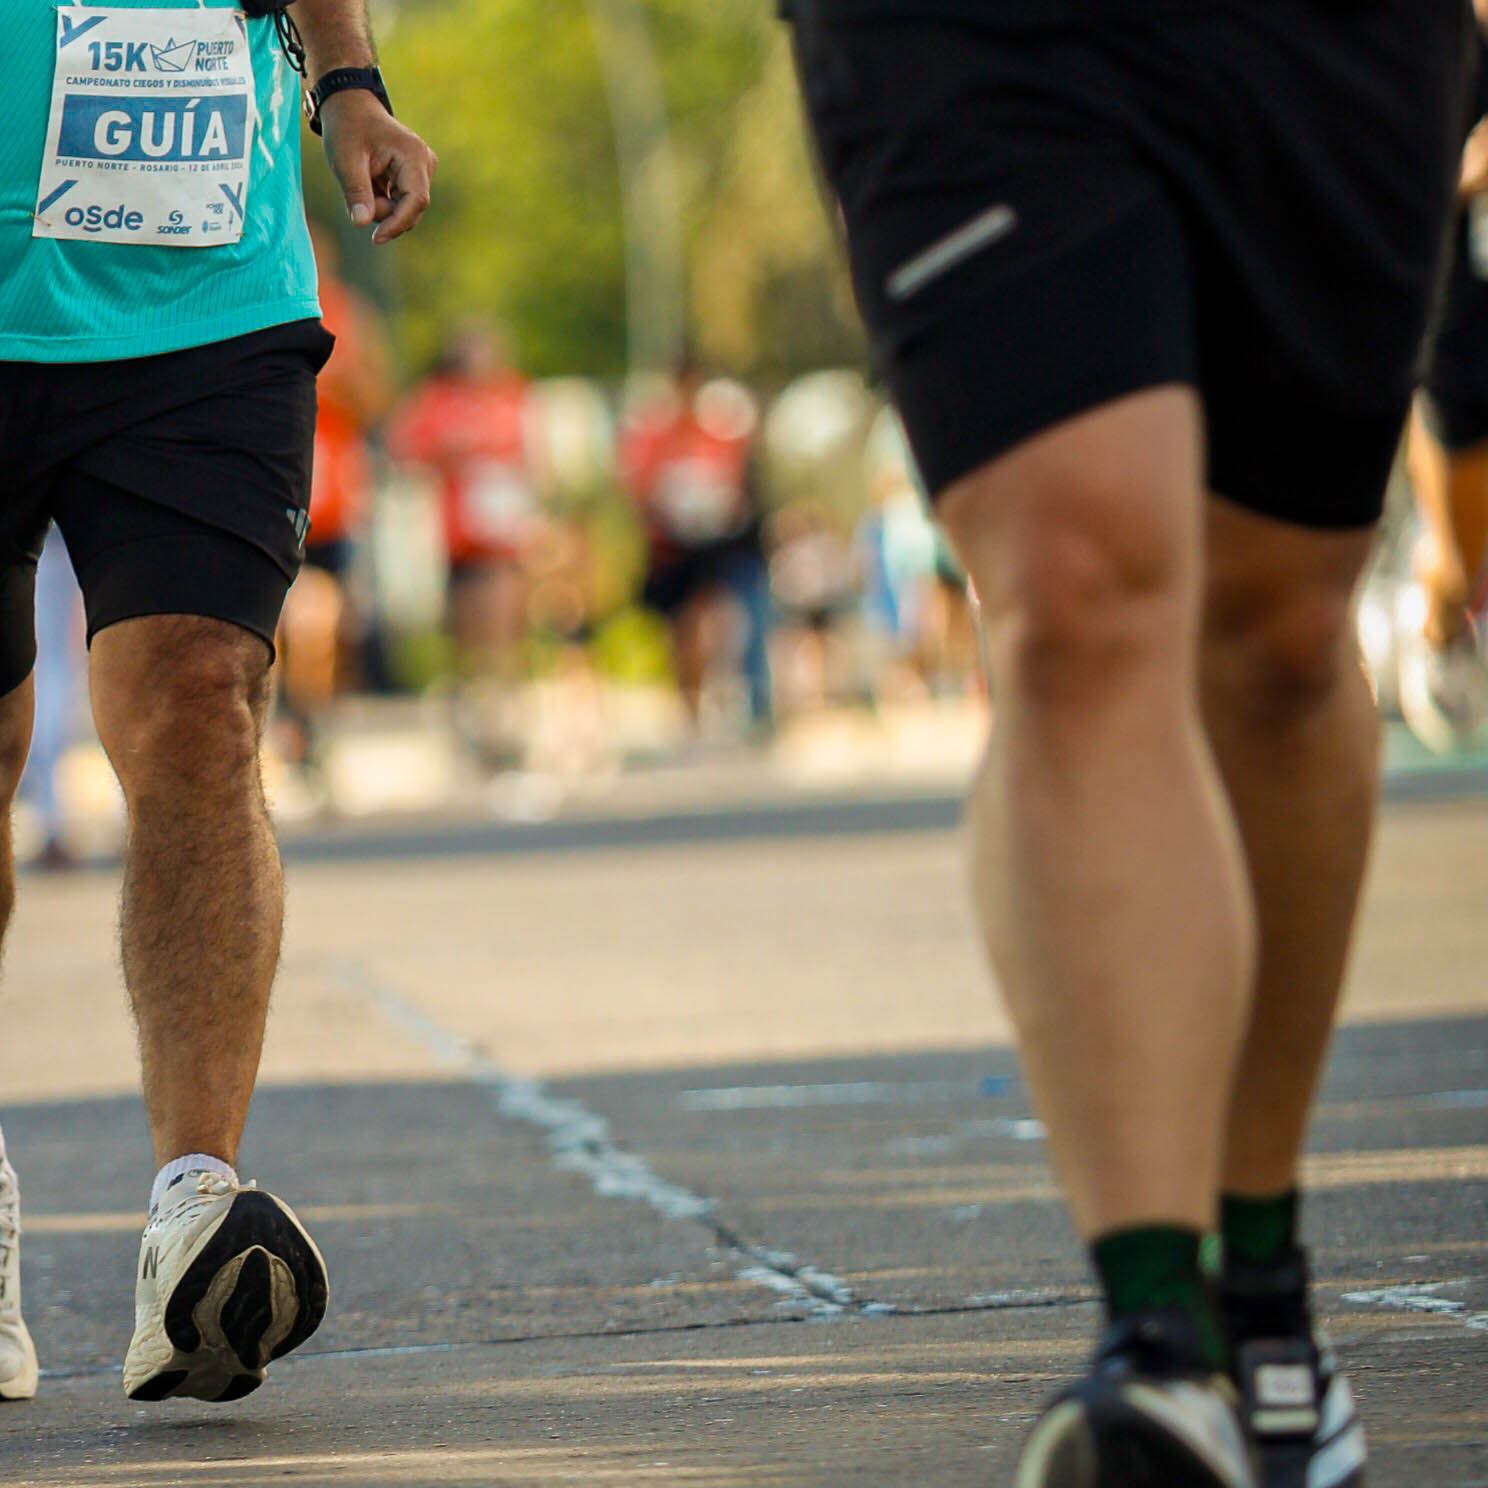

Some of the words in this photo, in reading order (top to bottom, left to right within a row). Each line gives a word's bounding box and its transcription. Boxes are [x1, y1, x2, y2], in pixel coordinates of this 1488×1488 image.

[197, 40, 234, 56] PUERTO
[88, 41, 148, 72] 15K
[195, 56, 228, 72] NORTE
[65, 76, 131, 88] CAMPEONATO
[133, 78, 164, 89] CIEGOS
[166, 79, 172, 89] Y
[94, 98, 229, 157] GUÍA
[55, 158, 93, 169] PUERTO
[97, 161, 129, 172] NORTE
[140, 163, 178, 173] ROSARIO
[65, 205, 143, 231] osde
